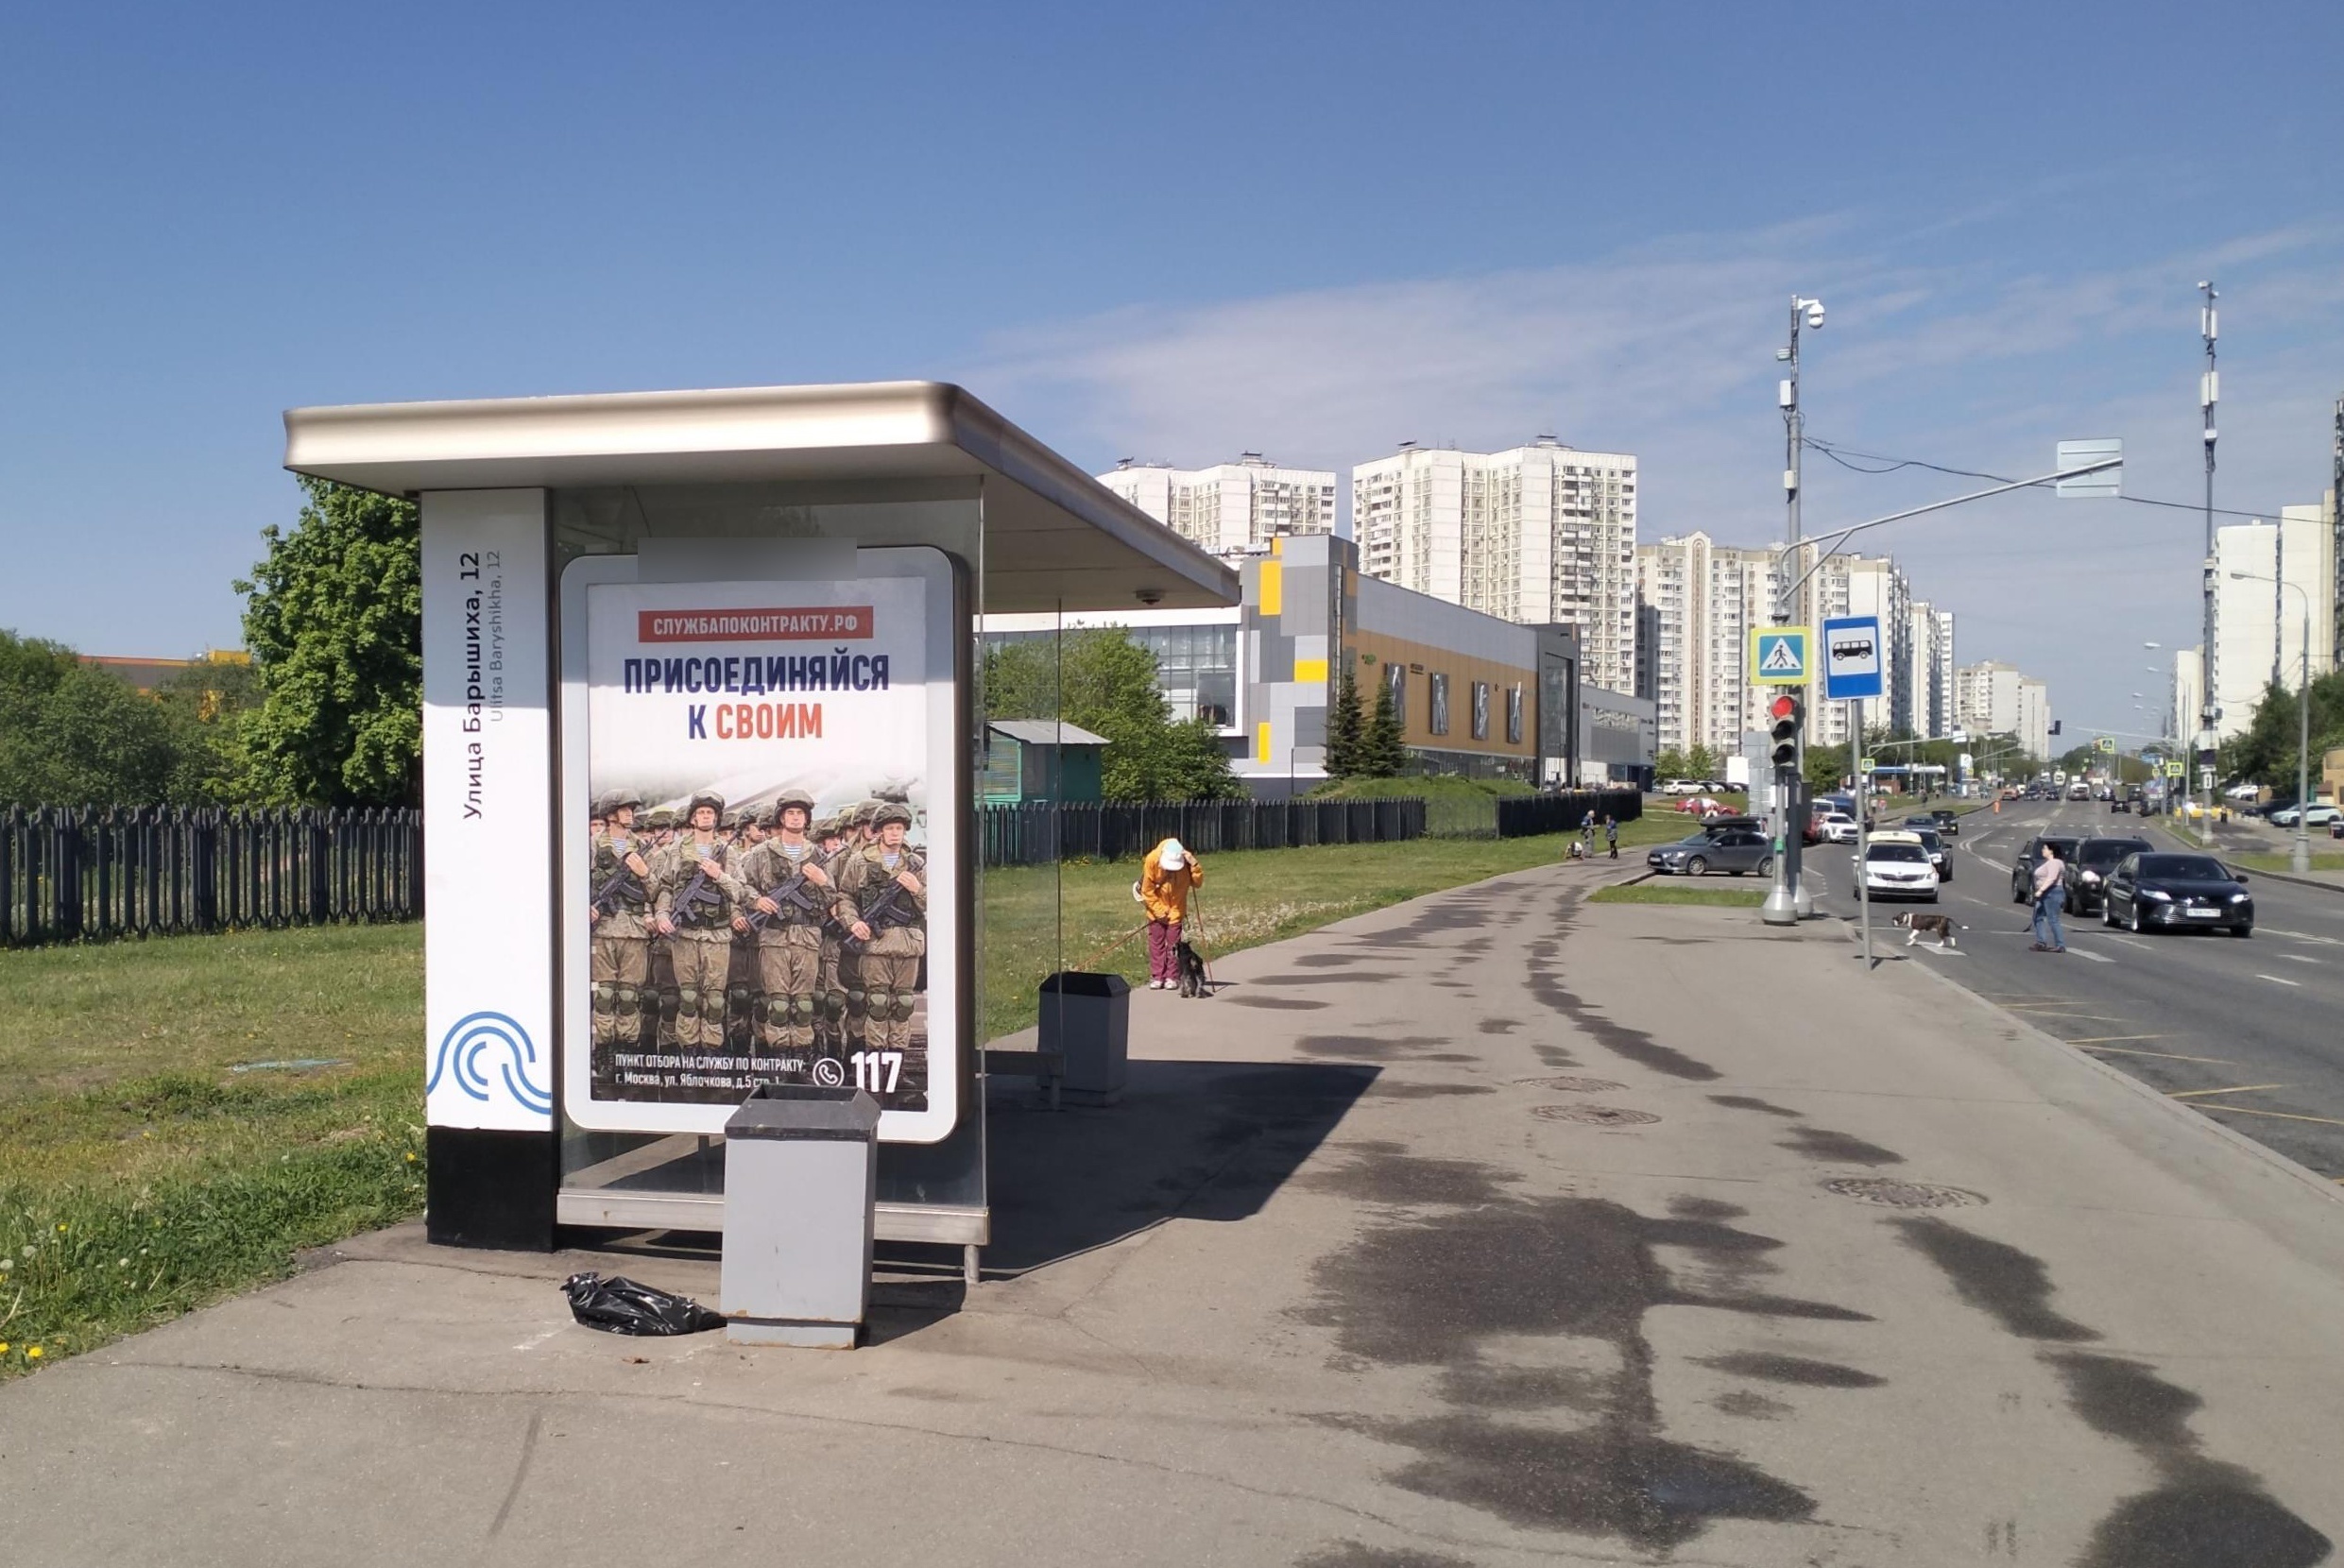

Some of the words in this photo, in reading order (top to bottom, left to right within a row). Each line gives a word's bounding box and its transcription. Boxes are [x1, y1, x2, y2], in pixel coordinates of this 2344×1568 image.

[460, 552, 480, 580] 12
[487, 551, 501, 569] 12
[488, 575, 505, 671] Baryshikha,
[653, 614, 859, 636] СЛУЖБАПОКОНТРАКТУ.РФ
[463, 589, 485, 733] Барышиха,
[624, 647, 889, 696] ПРИСОЕДИНЯЙСЯ
[489, 676, 503, 722] Ulitsa
[689, 705, 707, 740] К
[716, 703, 822, 739] СВОИМ
[462, 742, 485, 819] Улица
[615, 1053, 644, 1067] ПУНКТ
[645, 1054, 681, 1068] ОТБОРА
[682, 1057, 695, 1069] НА
[695, 1056, 734, 1070] СЛУЖБУ
[736, 1057, 749, 1071] ПО
[615, 1073, 623, 1083] г.
[624, 1071, 663, 1087] Москва,
[664, 1075, 678, 1088] ул.
[679, 1073, 734, 1090] Яблочкова,
[851, 1051, 903, 1093] 117
